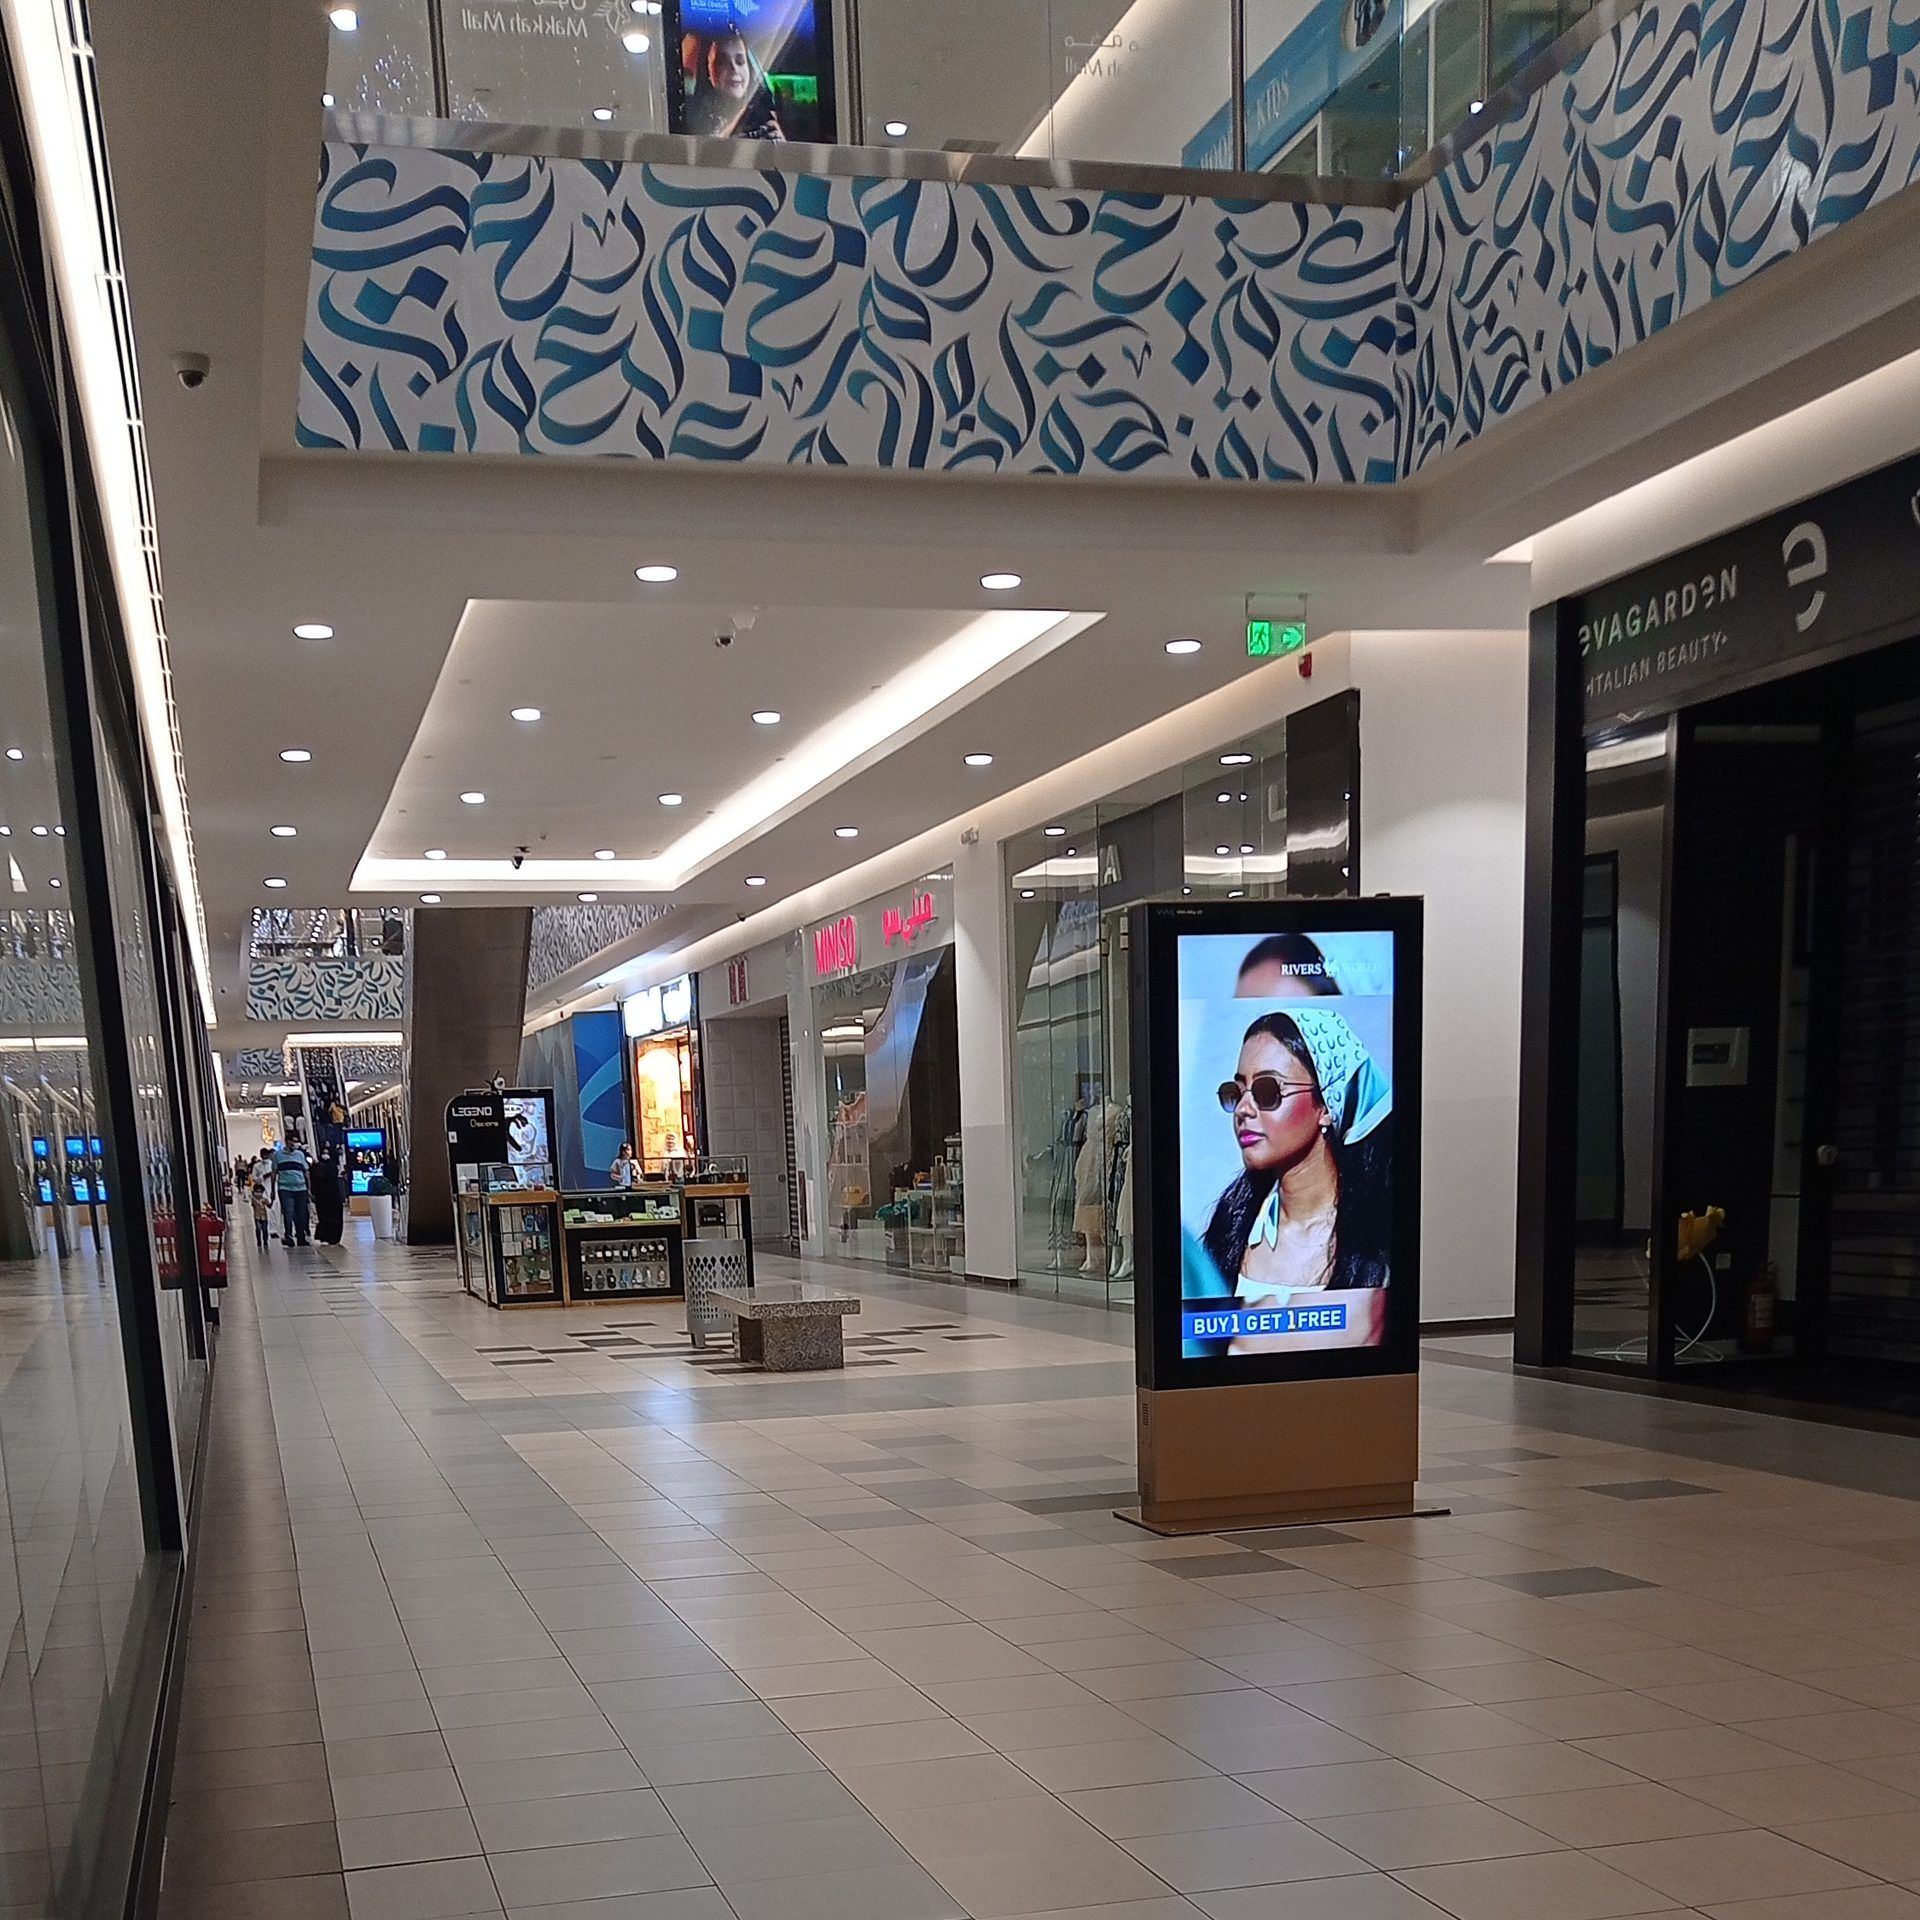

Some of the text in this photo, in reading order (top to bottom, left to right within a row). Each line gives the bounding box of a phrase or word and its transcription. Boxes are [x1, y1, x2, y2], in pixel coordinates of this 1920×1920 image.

[813, 914, 857, 976] MINISO
[1281, 963, 1322, 976] RIVERS
[452, 1106, 492, 1117] LEGEND
[1246, 1313, 1282, 1331] GET
